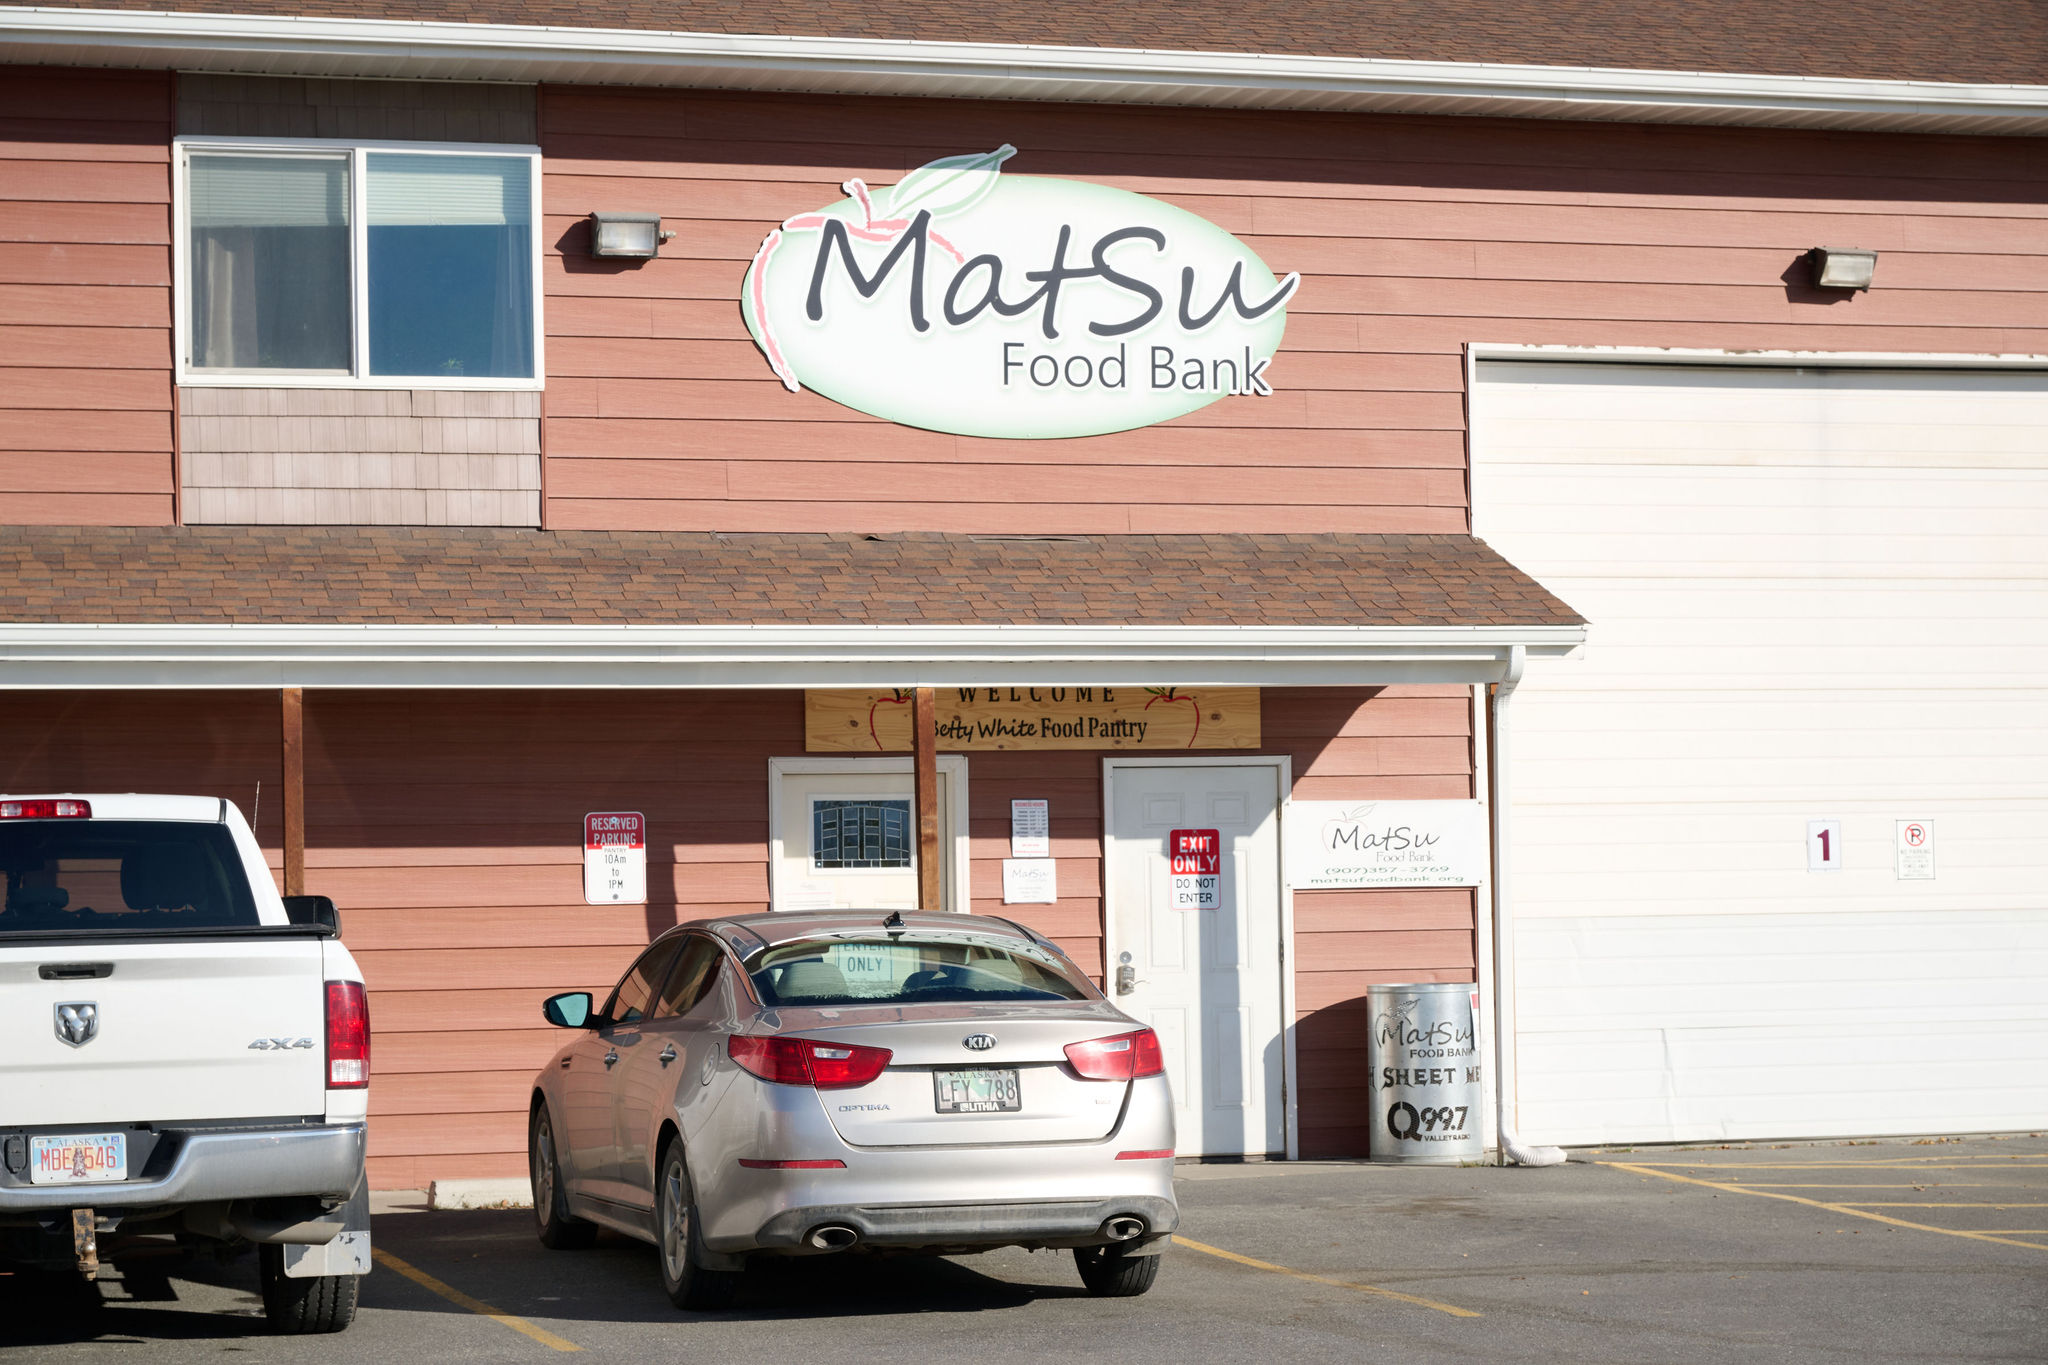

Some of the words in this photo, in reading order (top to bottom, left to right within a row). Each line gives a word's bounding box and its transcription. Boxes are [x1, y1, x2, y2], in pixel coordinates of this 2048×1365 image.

[805, 208, 1298, 339] MatSu
[1002, 342, 1127, 389] Food
[1150, 344, 1271, 392] Bank
[958, 687, 1114, 703] WELCOME
[977, 718, 1038, 738] White
[1041, 716, 1085, 738] Food
[1088, 717, 1148, 743] Pantry
[591, 817, 638, 831] RESERVED
[593, 833, 637, 846] PARKING
[1179, 836, 1212, 853] EXIT
[1332, 825, 1441, 851] MatSu
[1817, 829, 1830, 861] 1
[1173, 855, 1217, 872] ONLY
[1376, 851, 1406, 863] Food
[1409, 851, 1435, 862] Bank
[612, 868, 620, 877] to
[608, 880, 624, 889] 1PM
[1176, 878, 1190, 889] DO
[1195, 877, 1215, 889] NOT
[1310, 875, 1465, 885] matsufoodbank.org
[1179, 892, 1213, 903] ENTER
[847, 956, 883, 972] ONLY
[968, 1036, 993, 1049] KIA
[1409, 1049, 1444, 1059] FOOD
[1447, 1047, 1474, 1058] BANK
[954, 1071, 999, 1079] ALASKA
[1381, 1066, 1457, 1091] SHEET
[939, 1079, 971, 1102] LFY
[984, 1079, 1016, 1101] 788
[838, 1104, 890, 1112] OPTIMA
[969, 1101, 1000, 1112] LITHIA
[56, 1138, 101, 1147] ALASKA
[84, 1145, 117, 1169] 546
